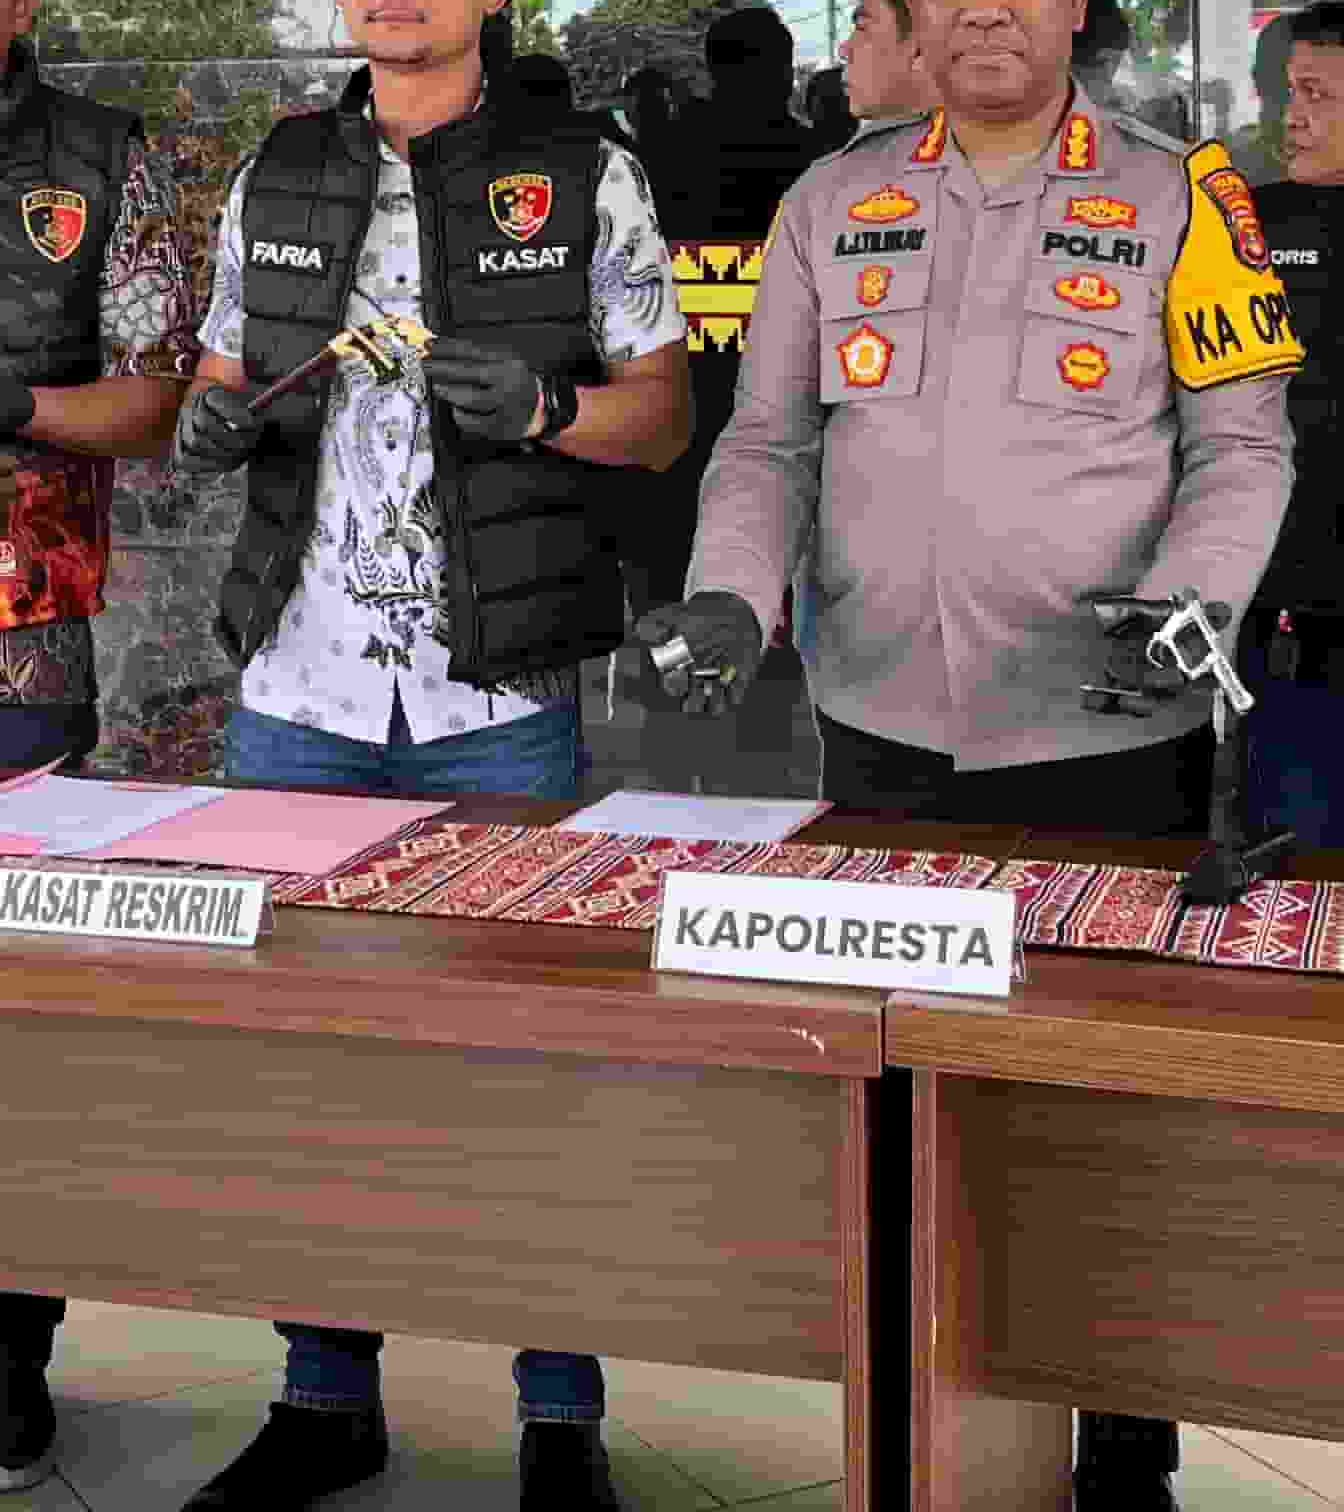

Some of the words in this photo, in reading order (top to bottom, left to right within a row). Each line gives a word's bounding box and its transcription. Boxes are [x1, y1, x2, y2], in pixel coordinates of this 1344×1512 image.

[251, 240, 324, 270] FARIA
[479, 246, 569, 273] KASAT
[1041, 232, 1146, 268] POLRI
[1183, 303, 1244, 364] KA
[1248, 293, 1298, 346] OP
[0, 871, 103, 927] KASAT
[674, 905, 994, 968] KAPOLRESTA
